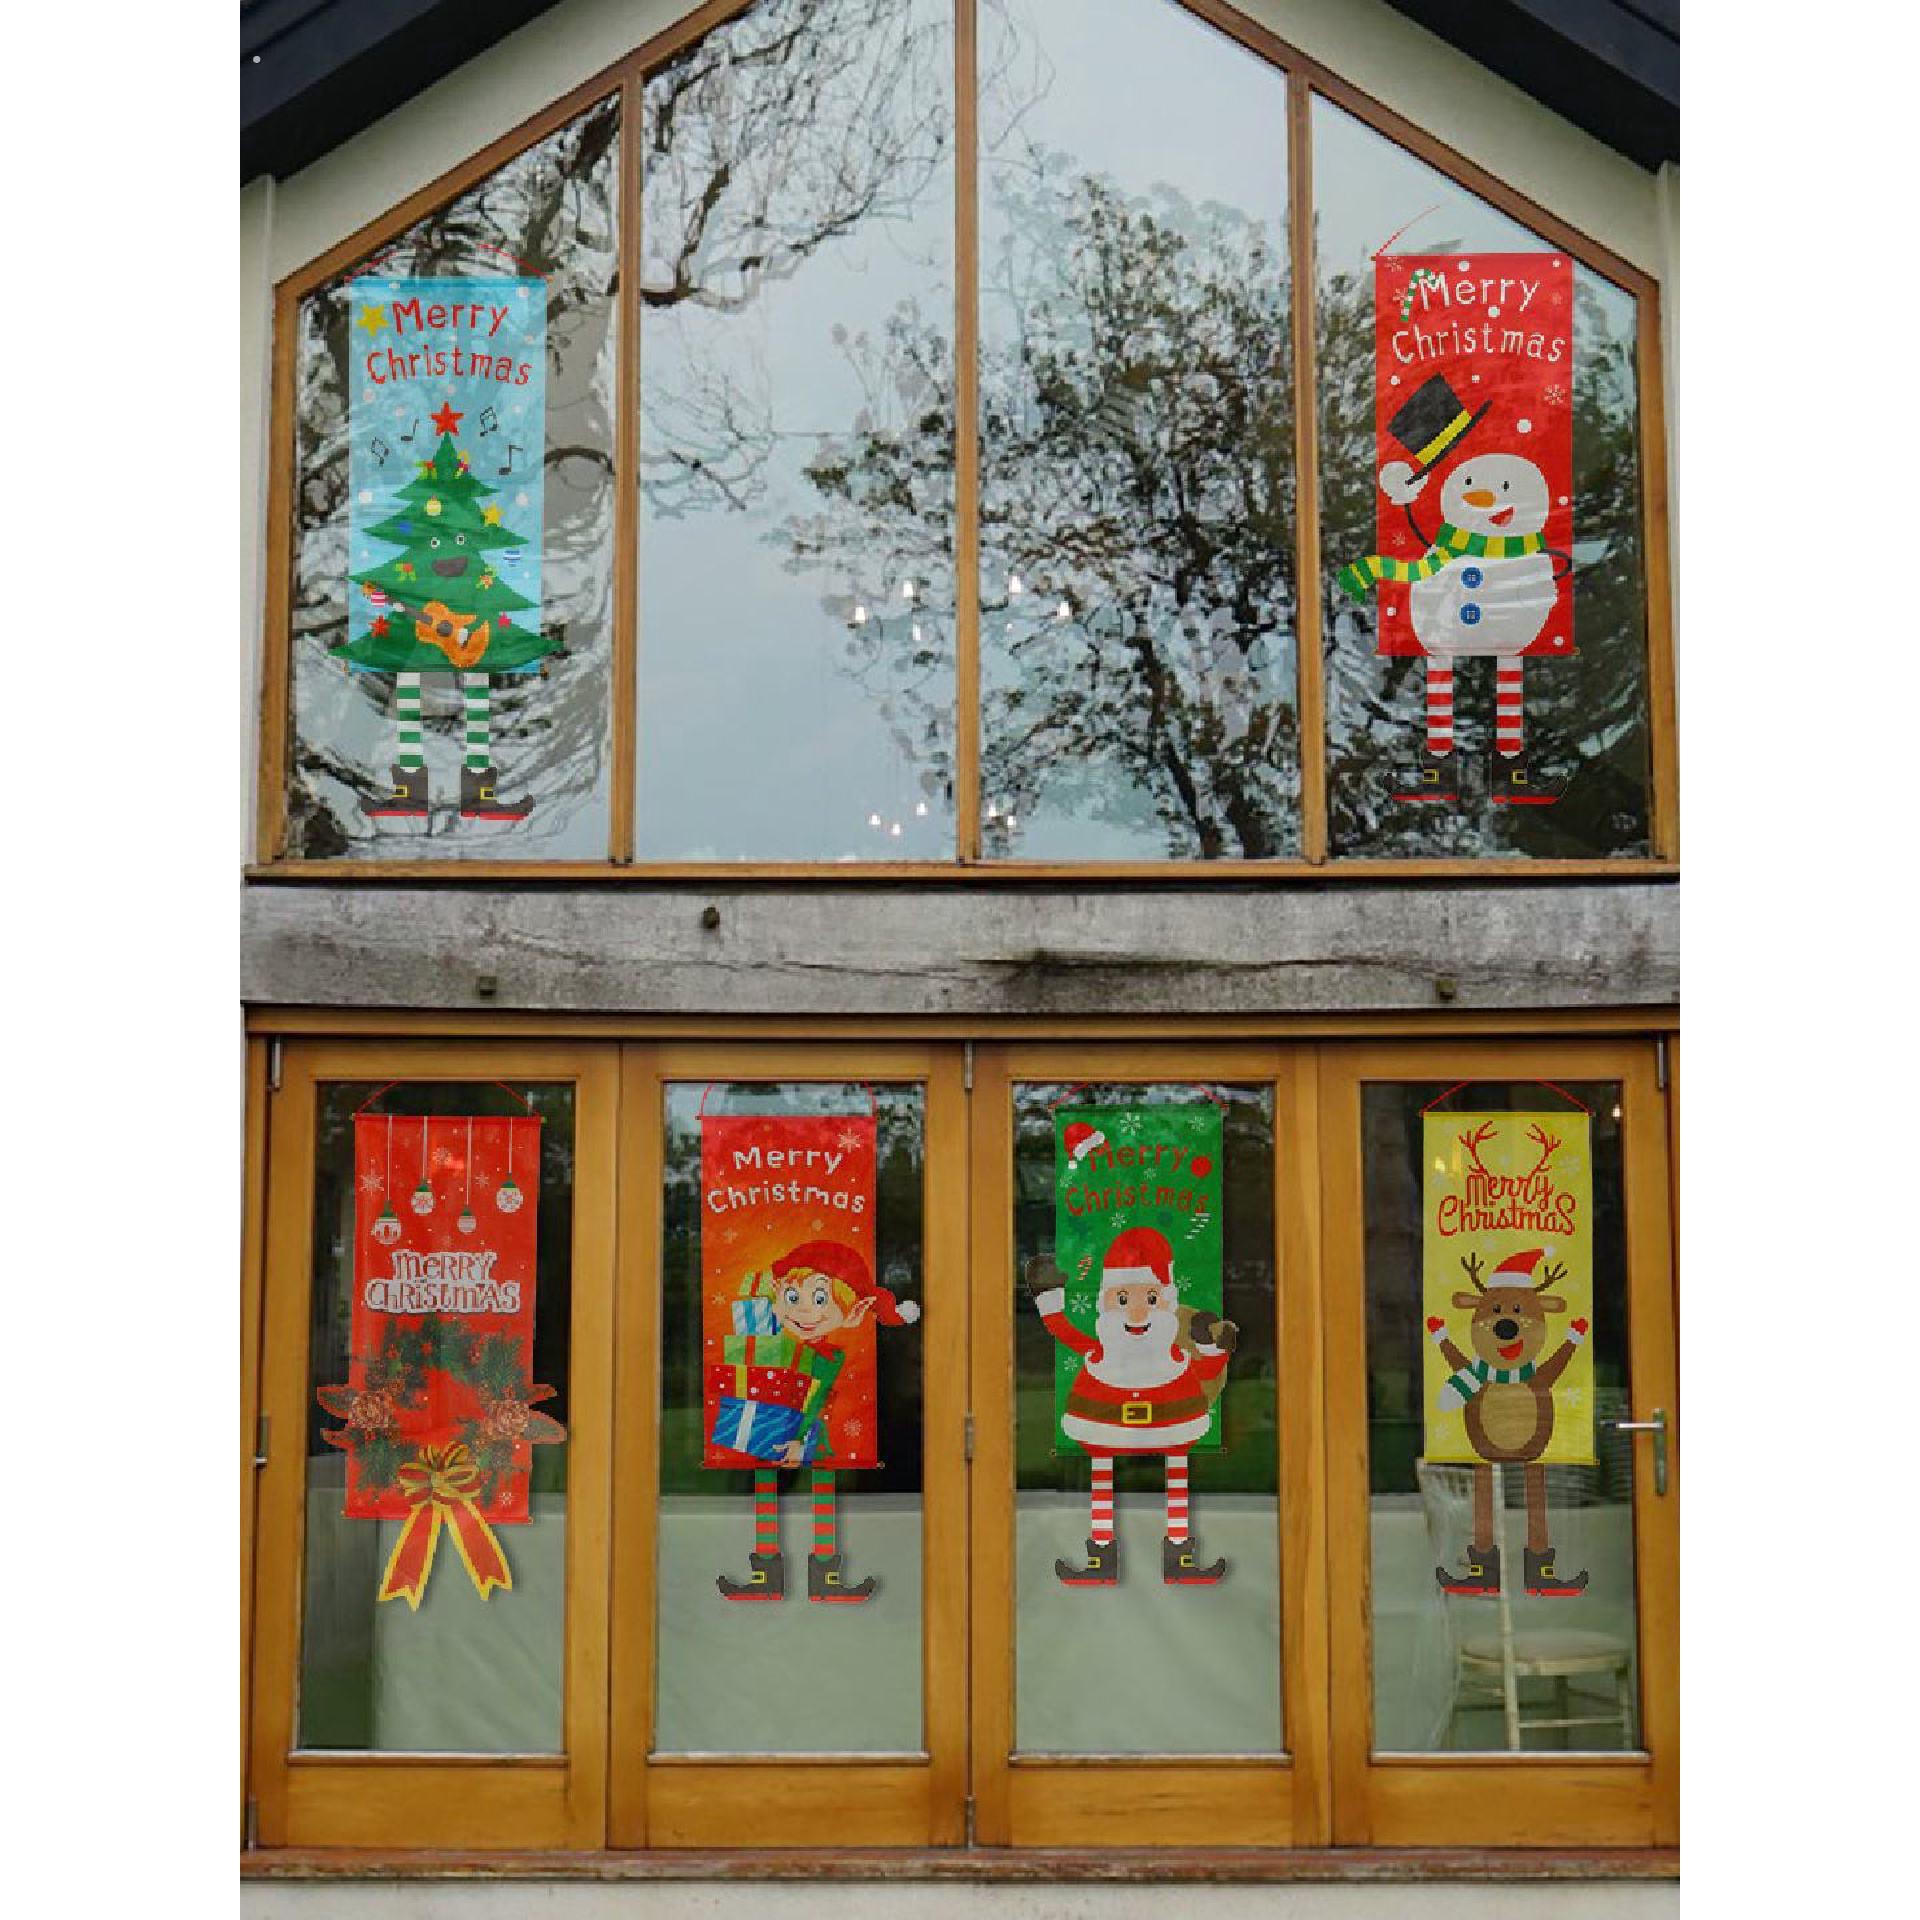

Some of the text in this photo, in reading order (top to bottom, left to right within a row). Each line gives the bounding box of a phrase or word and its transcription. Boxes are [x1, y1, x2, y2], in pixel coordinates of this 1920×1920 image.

[1418, 272, 1541, 311] Merry
[392, 297, 510, 336] Merry
[1392, 321, 1566, 364] Christmas
[367, 344, 533, 385] Christmas
[733, 1146, 843, 1175] Merry
[1088, 1140, 1189, 1173] Merry
[707, 1180, 865, 1213] Christmas
[1466, 1174, 1555, 1212] Merry
